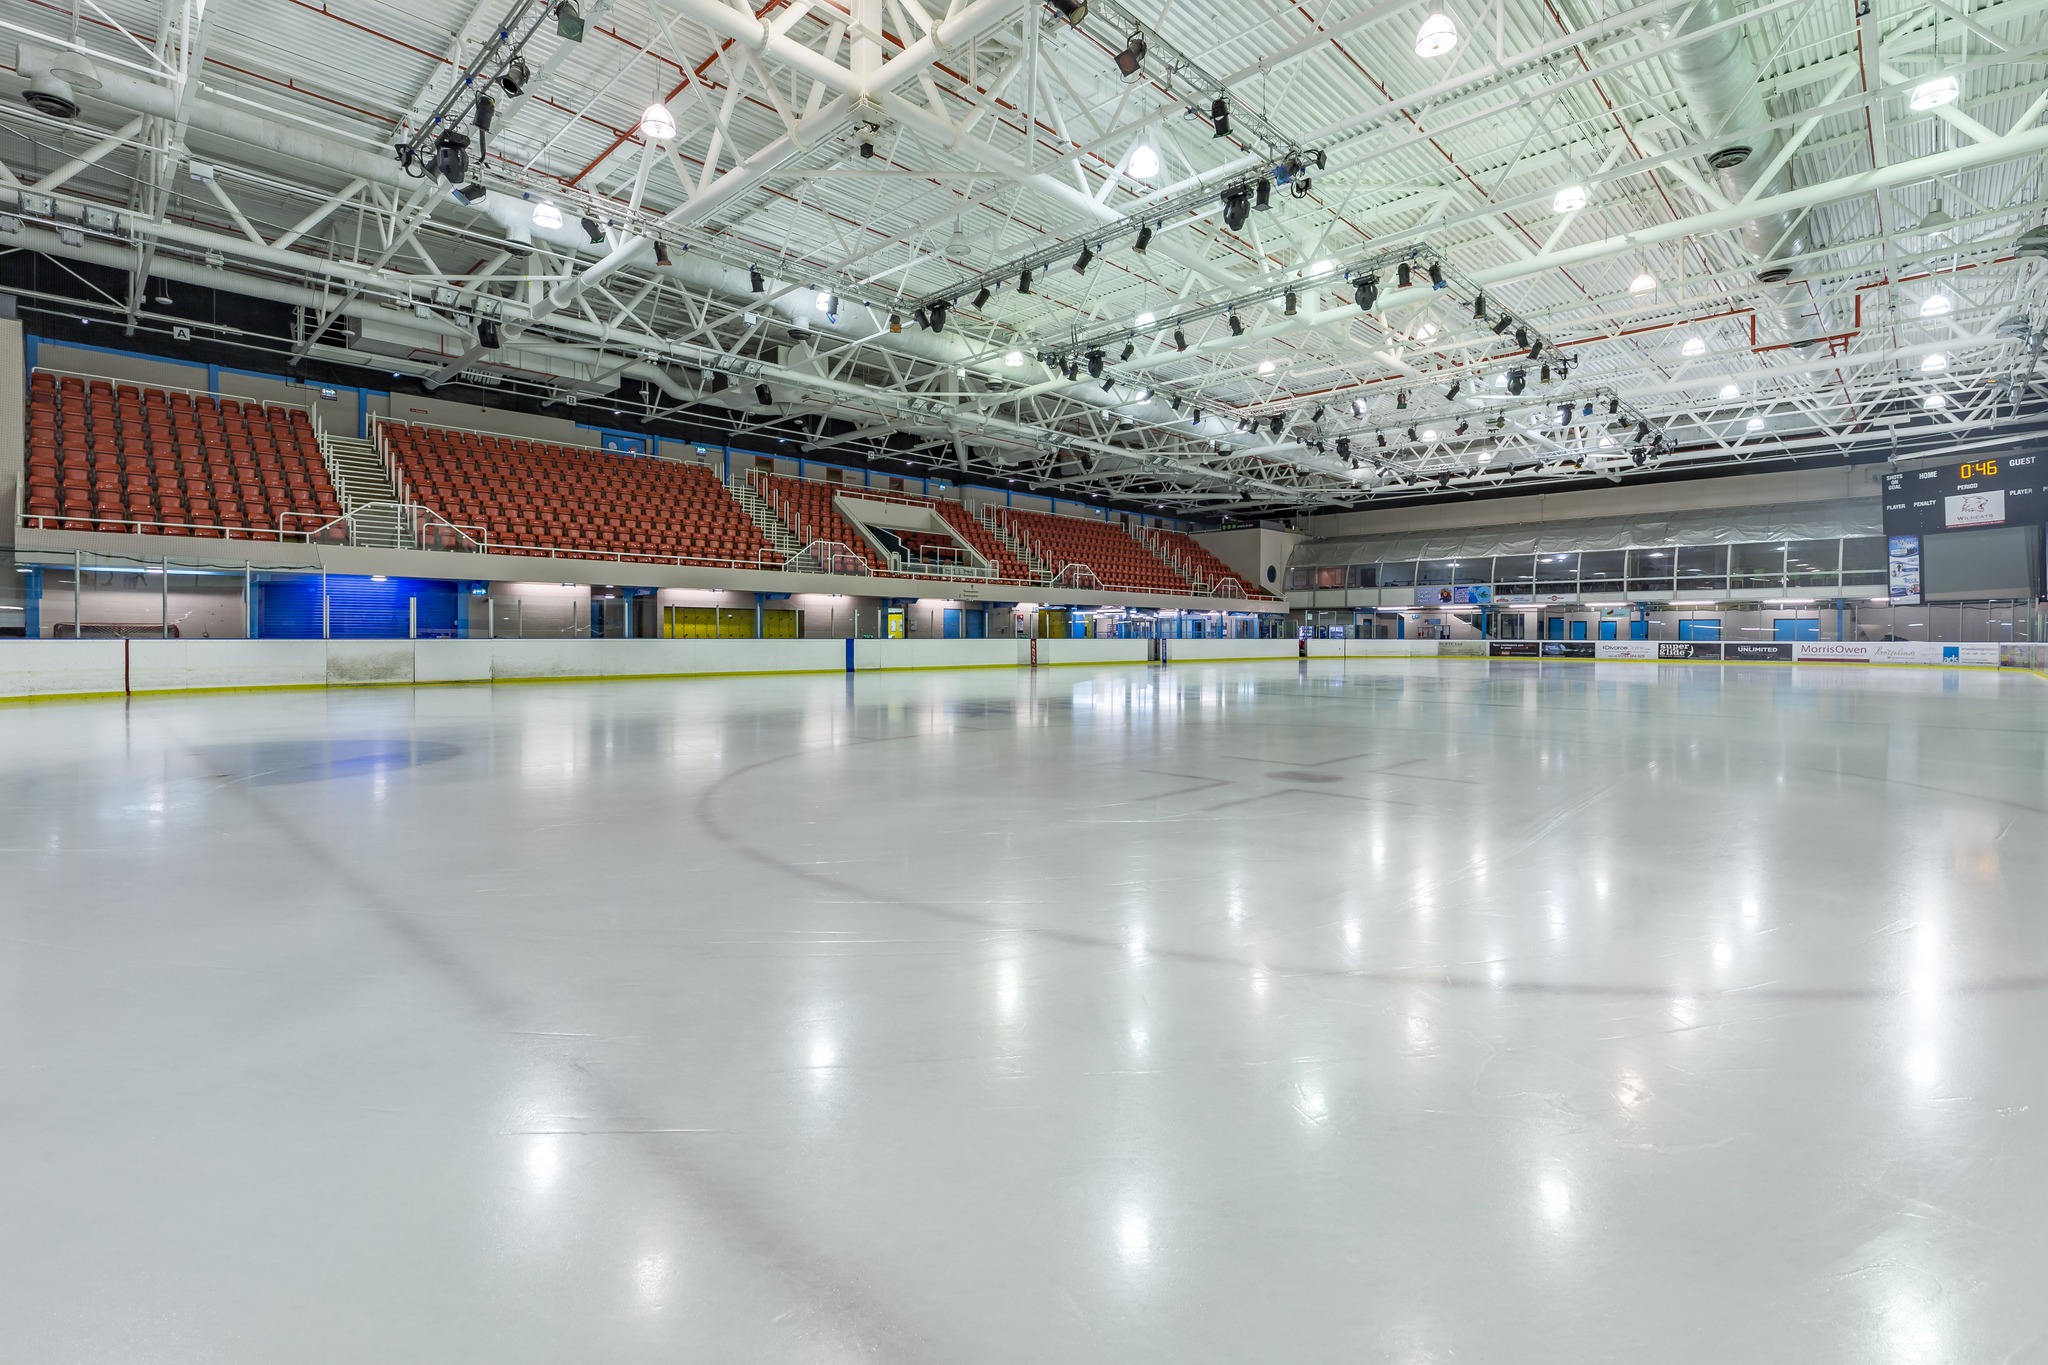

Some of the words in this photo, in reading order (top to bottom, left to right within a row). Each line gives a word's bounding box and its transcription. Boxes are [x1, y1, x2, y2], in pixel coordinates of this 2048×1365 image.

[177, 329, 187, 338] A
[2009, 456, 2036, 467] GUEST
[1960, 460, 1998, 479] 0:46
[1918, 471, 1938, 480] HOME
[1957, 482, 1979, 491] PERIOD
[2009, 487, 2033, 496] PLAYER
[1914, 500, 1936, 508] PENALTY
[1659, 643, 1690, 651] super
[1800, 644, 1867, 654] MorrisOwen
[1659, 648, 1686, 657] glide
[1943, 654, 1959, 664] ads
